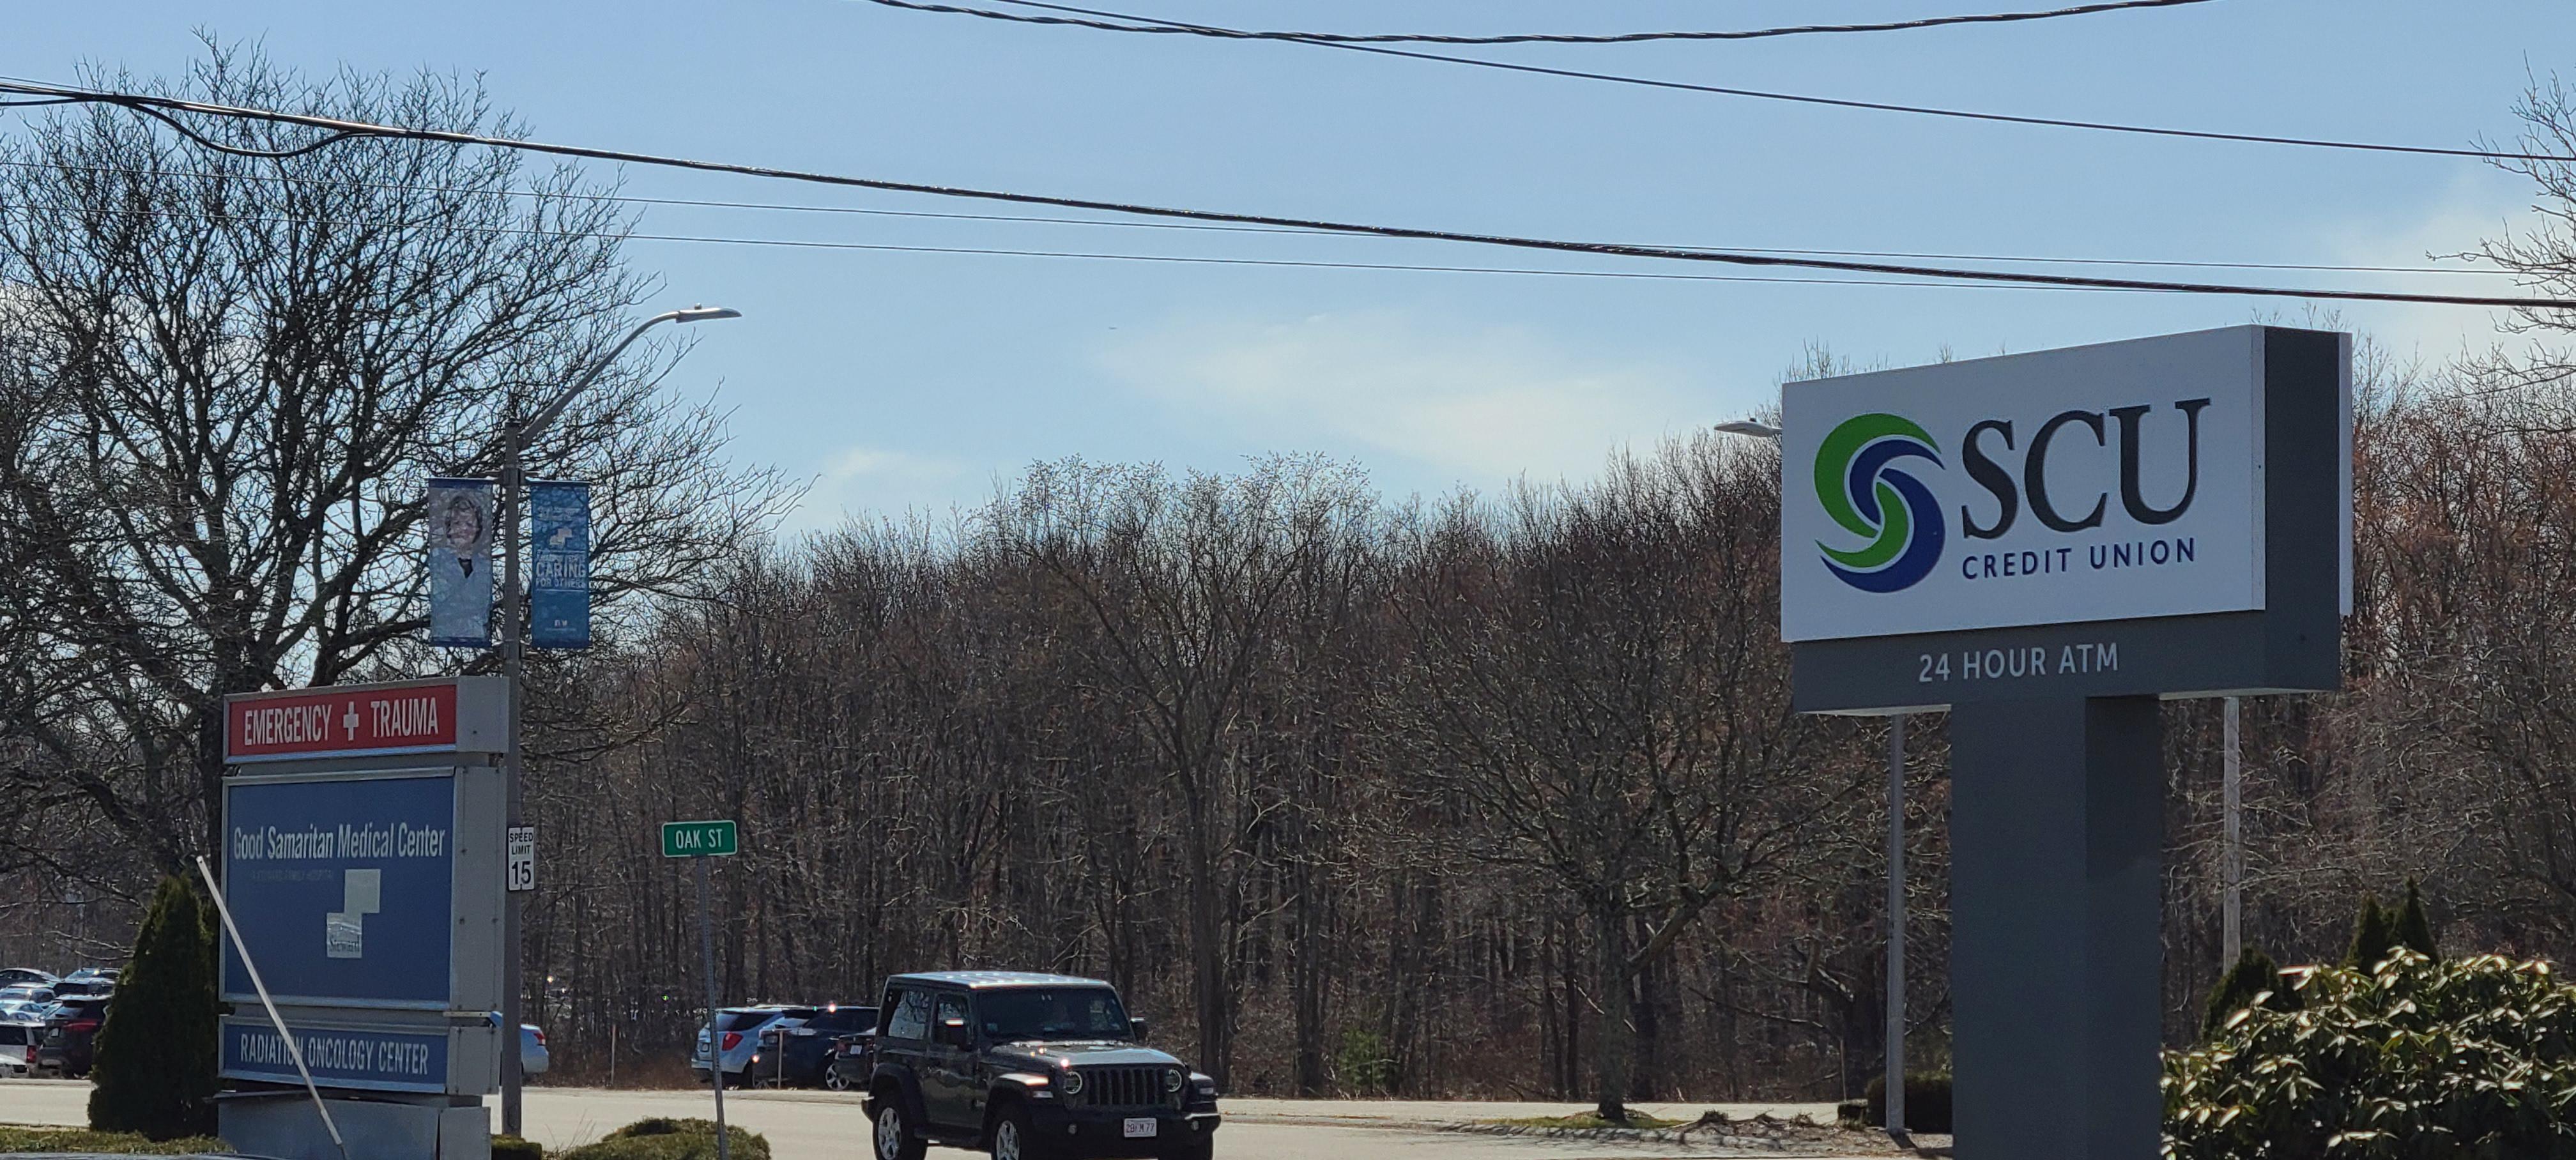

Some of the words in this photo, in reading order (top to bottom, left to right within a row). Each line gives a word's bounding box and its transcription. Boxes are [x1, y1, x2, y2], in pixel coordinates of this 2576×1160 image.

[1961, 397, 2211, 539] SCU
[536, 562, 586, 577] CARING
[1962, 547, 2072, 580] CREDIT
[2089, 537, 2195, 570] UNION
[1919, 653, 1951, 683] 24
[1963, 647, 2046, 680] HOUR
[2058, 642, 2118, 675] ATM
[244, 704, 332, 746] EMERGENCY
[371, 697, 439, 738] TRAUMA
[234, 826, 264, 860] Good
[268, 823, 334, 860] Samaritan
[337, 822, 394, 859] Medical
[397, 821, 445, 857] Center
[509, 832, 533, 843] SPEED
[512, 845, 531, 855] LIMIT
[676, 829, 702, 849] OAK
[708, 828, 723, 848] ST
[512, 860, 531, 885] 15
[308, 1037, 374, 1071] ONCOLOGY
[378, 1041, 429, 1075] CENTER
